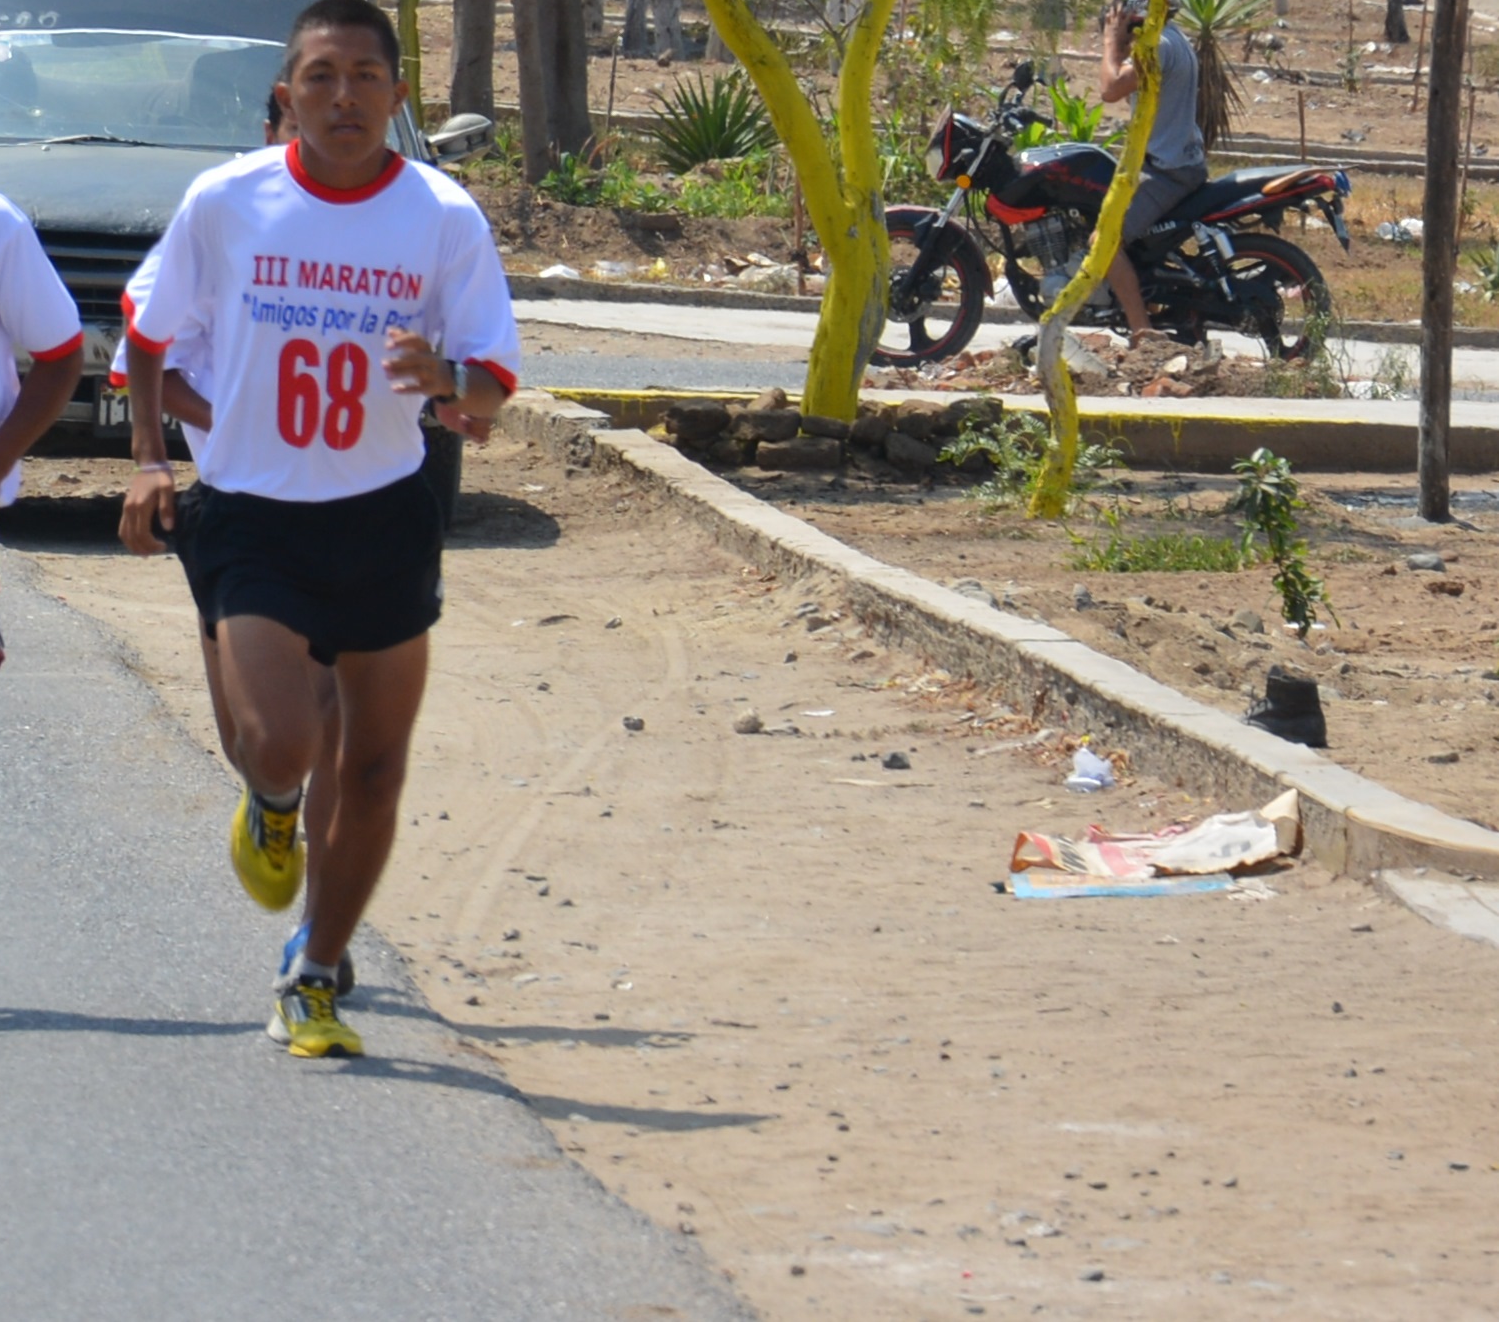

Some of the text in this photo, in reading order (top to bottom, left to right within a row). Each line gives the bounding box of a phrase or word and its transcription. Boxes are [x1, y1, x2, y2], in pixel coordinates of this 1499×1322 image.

[252, 255, 423, 301] III MARATÓN
[242, 292, 318, 332] "Amigos
[322, 305, 356, 336] por
[359, 305, 378, 334] la
[277, 338, 369, 451] 68
